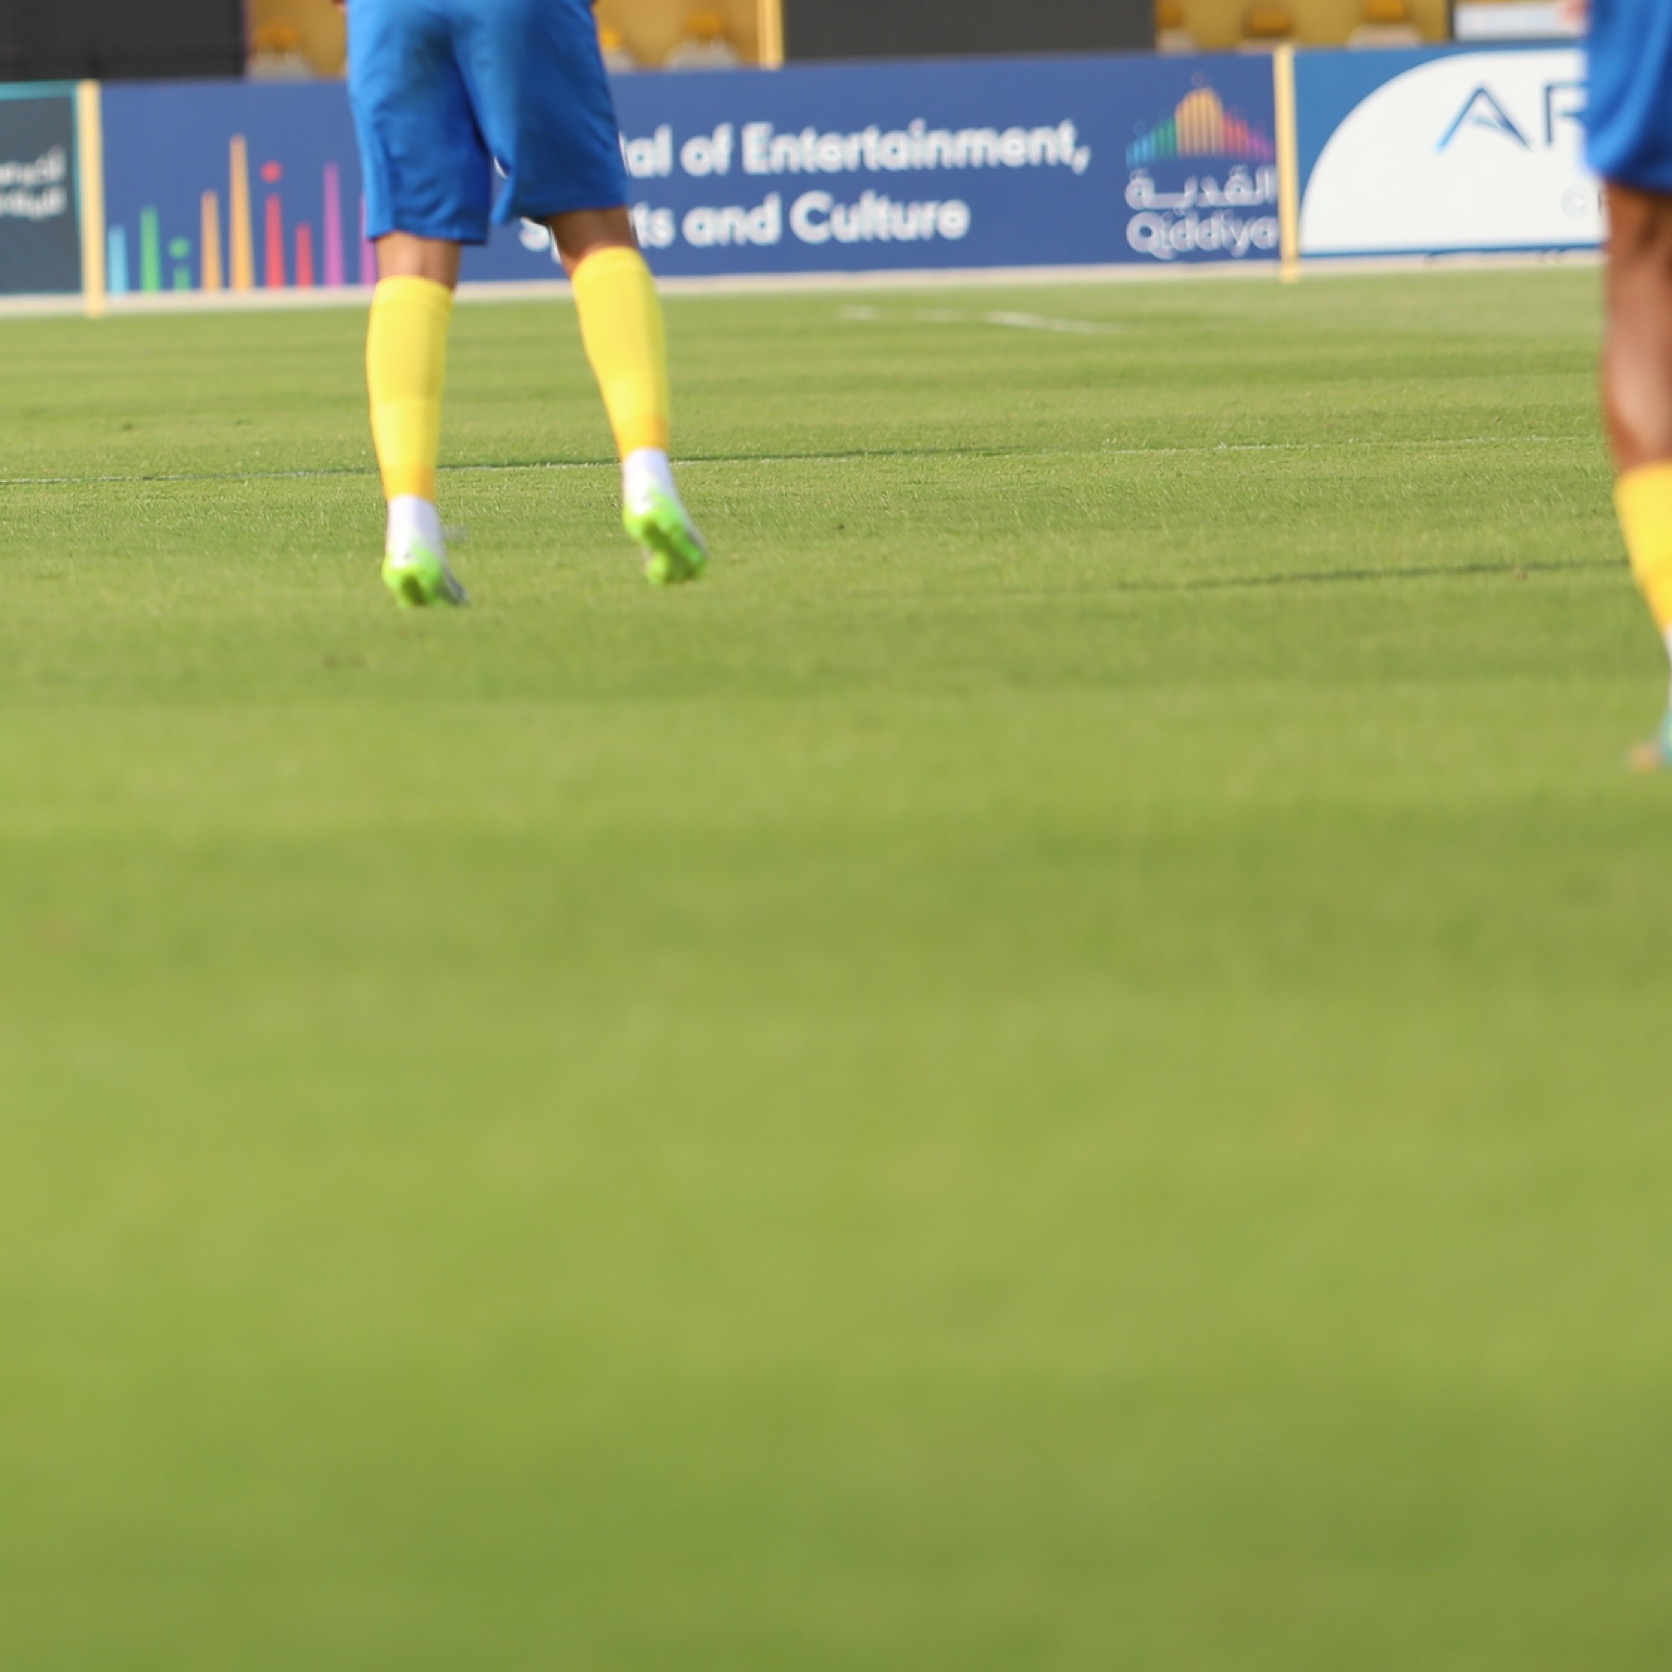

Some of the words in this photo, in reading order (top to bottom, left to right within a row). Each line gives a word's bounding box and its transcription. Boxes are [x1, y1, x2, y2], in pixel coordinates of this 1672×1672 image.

[680, 123, 733, 177] of
[741, 117, 1091, 176] Entertainment,
[682, 191, 782, 248] and
[789, 189, 971, 244] Culture
